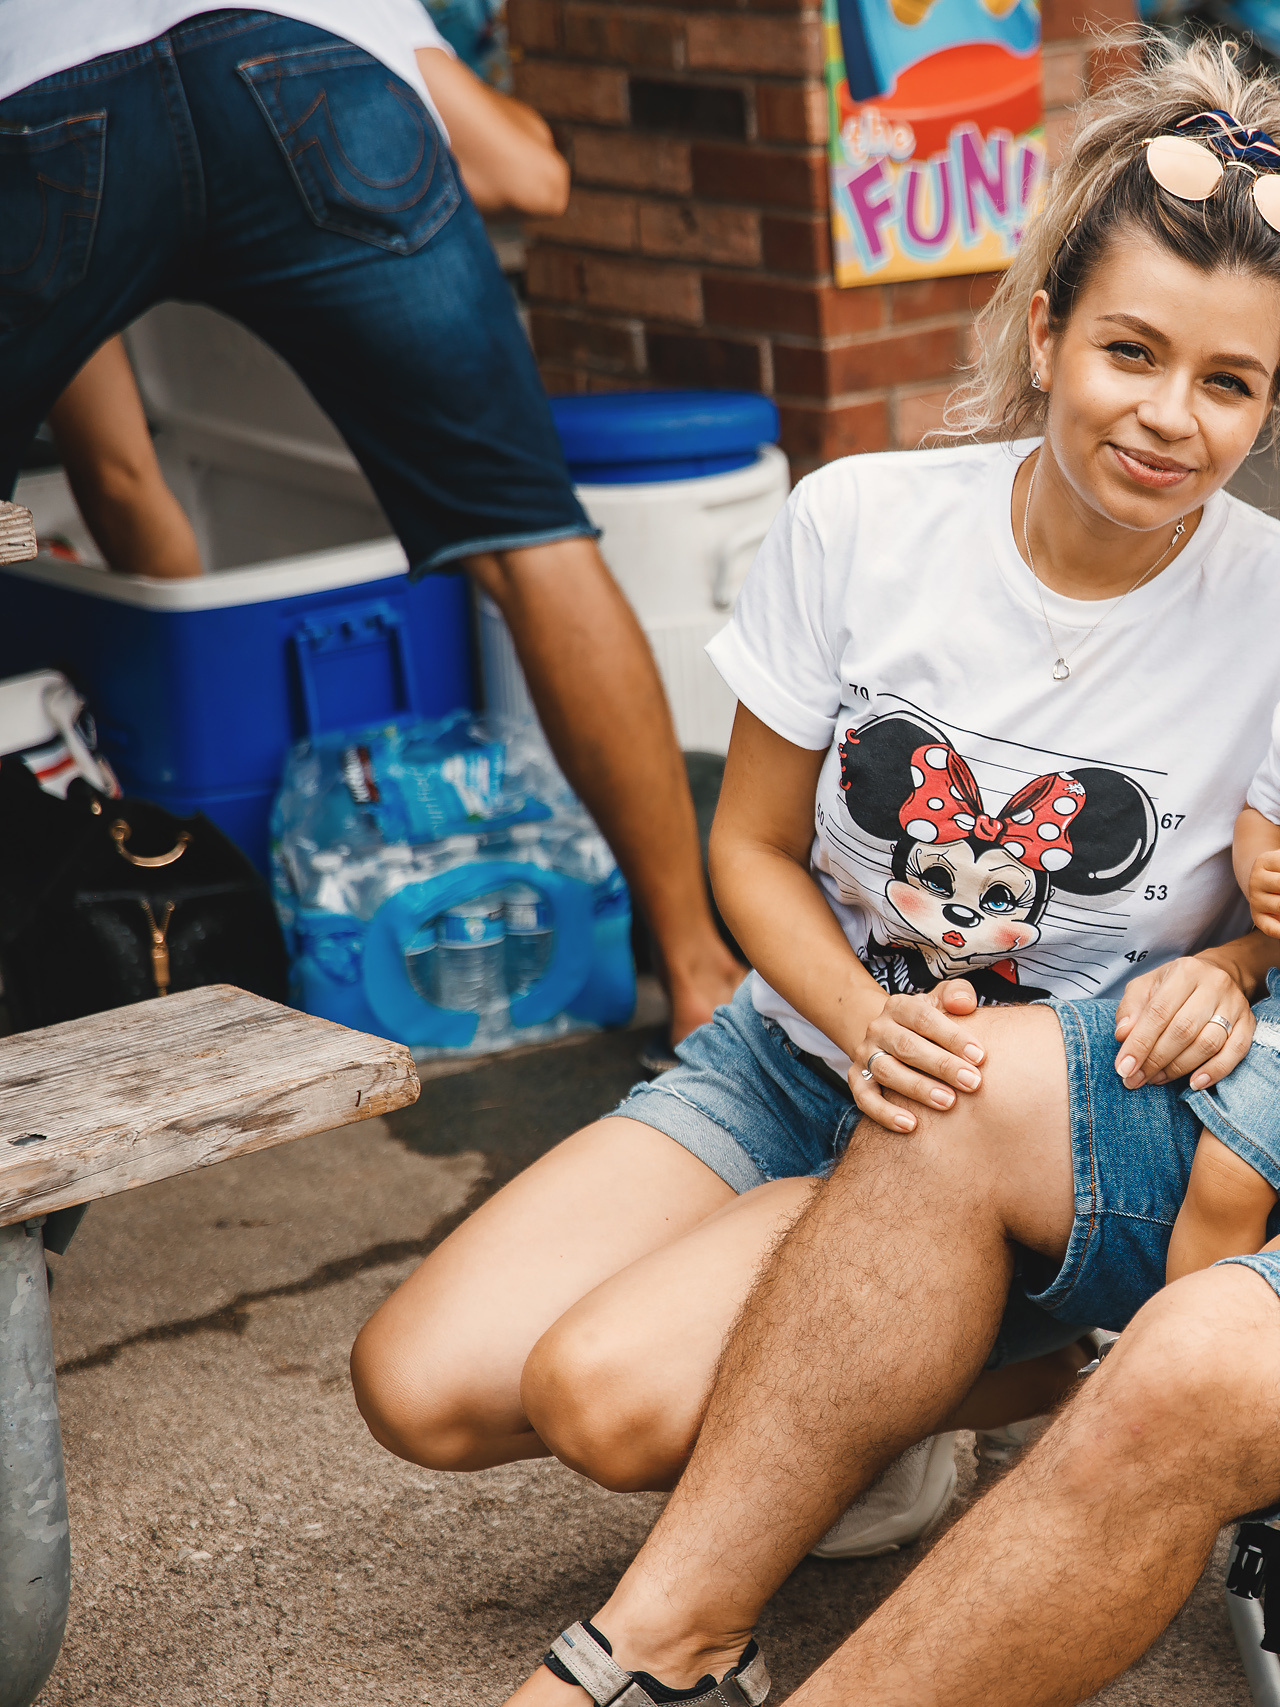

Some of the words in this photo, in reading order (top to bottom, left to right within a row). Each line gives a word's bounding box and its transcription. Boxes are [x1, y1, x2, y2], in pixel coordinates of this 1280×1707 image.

[839, 125, 1043, 266] FUN!
[849, 683, 870, 701] 70
[1160, 812, 1186, 831] 67
[1144, 885, 1168, 900] 53
